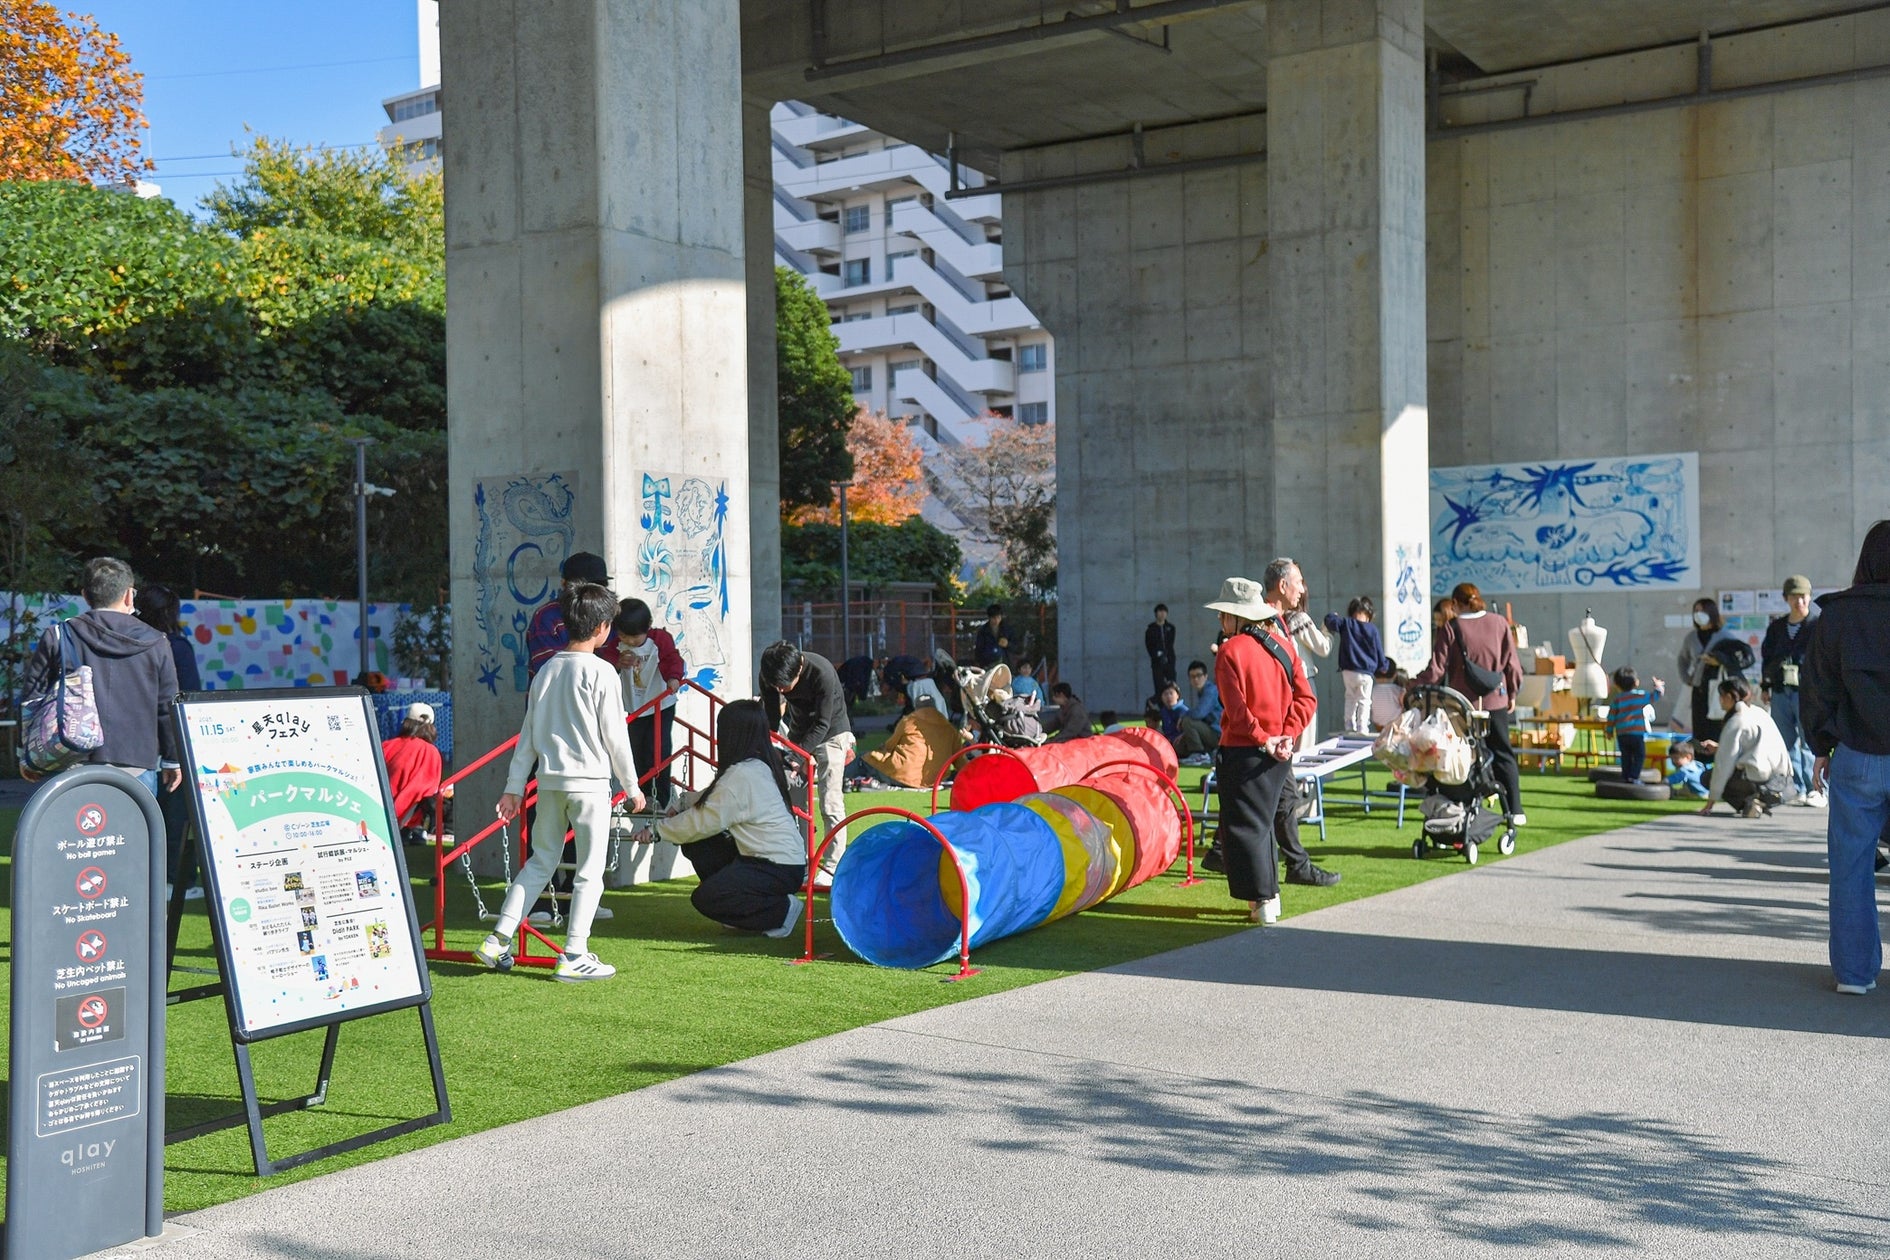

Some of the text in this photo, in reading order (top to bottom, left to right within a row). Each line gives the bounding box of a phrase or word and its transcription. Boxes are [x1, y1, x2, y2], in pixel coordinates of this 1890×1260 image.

[200, 723, 224, 736] 11.15
[269, 728, 299, 739] フェス
[250, 784, 361, 814] パークマルシェ
[56, 835, 126, 851] ボール遊び禁止
[66, 849, 116, 860] No ball games
[250, 857, 288, 869] ステージ企画
[53, 896, 129, 915] スケートボード禁止
[65, 911, 117, 924] No Skateboard
[56, 959, 125, 980] 芝生内ペット禁止
[55, 972, 126, 990] No Uncaged animals
[61, 1139, 116, 1167] qlay
[72, 1161, 106, 1175] HOSHITEN
